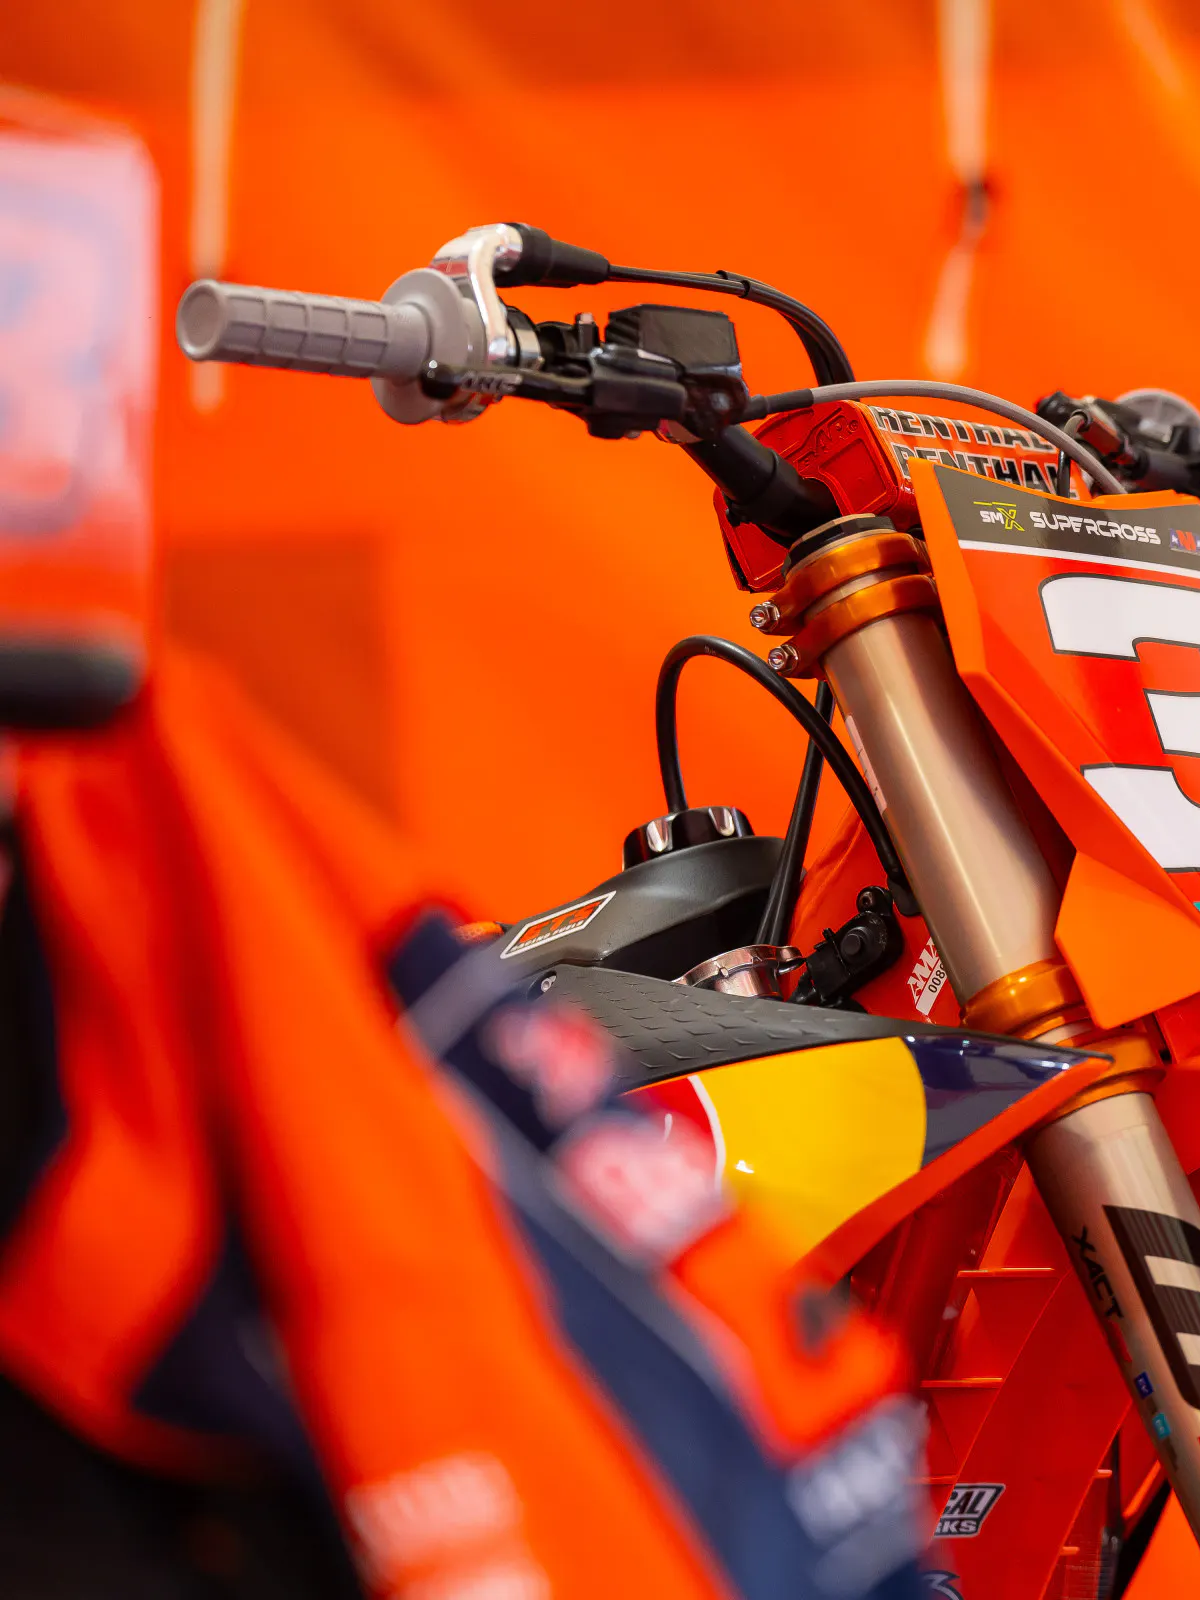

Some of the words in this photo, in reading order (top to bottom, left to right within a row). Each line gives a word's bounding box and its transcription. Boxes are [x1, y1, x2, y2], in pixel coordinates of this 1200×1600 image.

[868, 406, 1058, 452] RENTHAL
[1029, 511, 1161, 545] SUPERCROSS
[1072, 1226, 1124, 1319] XACT
